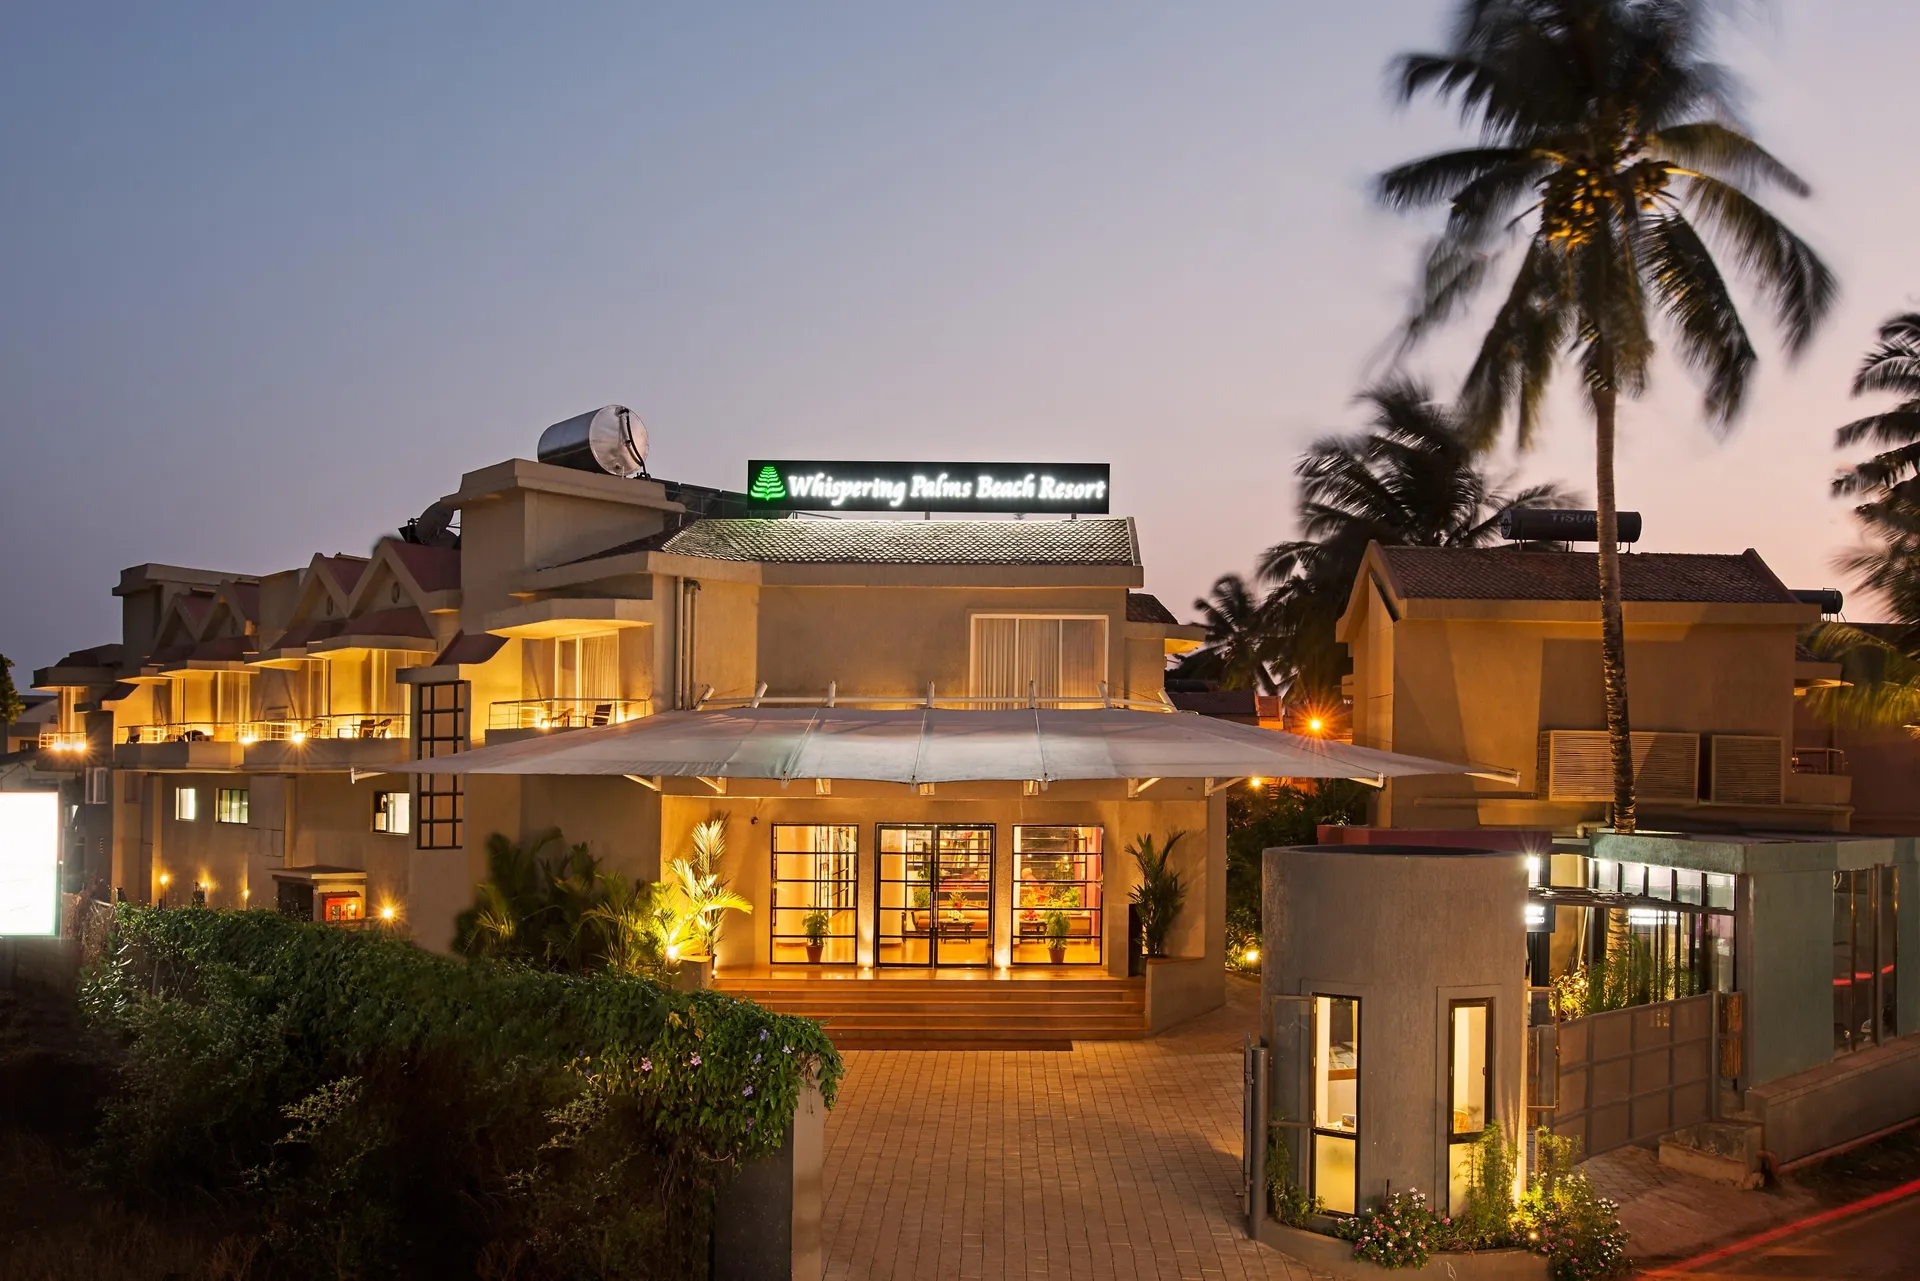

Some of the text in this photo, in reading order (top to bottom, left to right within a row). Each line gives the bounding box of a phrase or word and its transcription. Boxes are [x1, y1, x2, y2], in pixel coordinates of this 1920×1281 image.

[788, 472, 1106, 507] Whispering Palms Beach Resort
